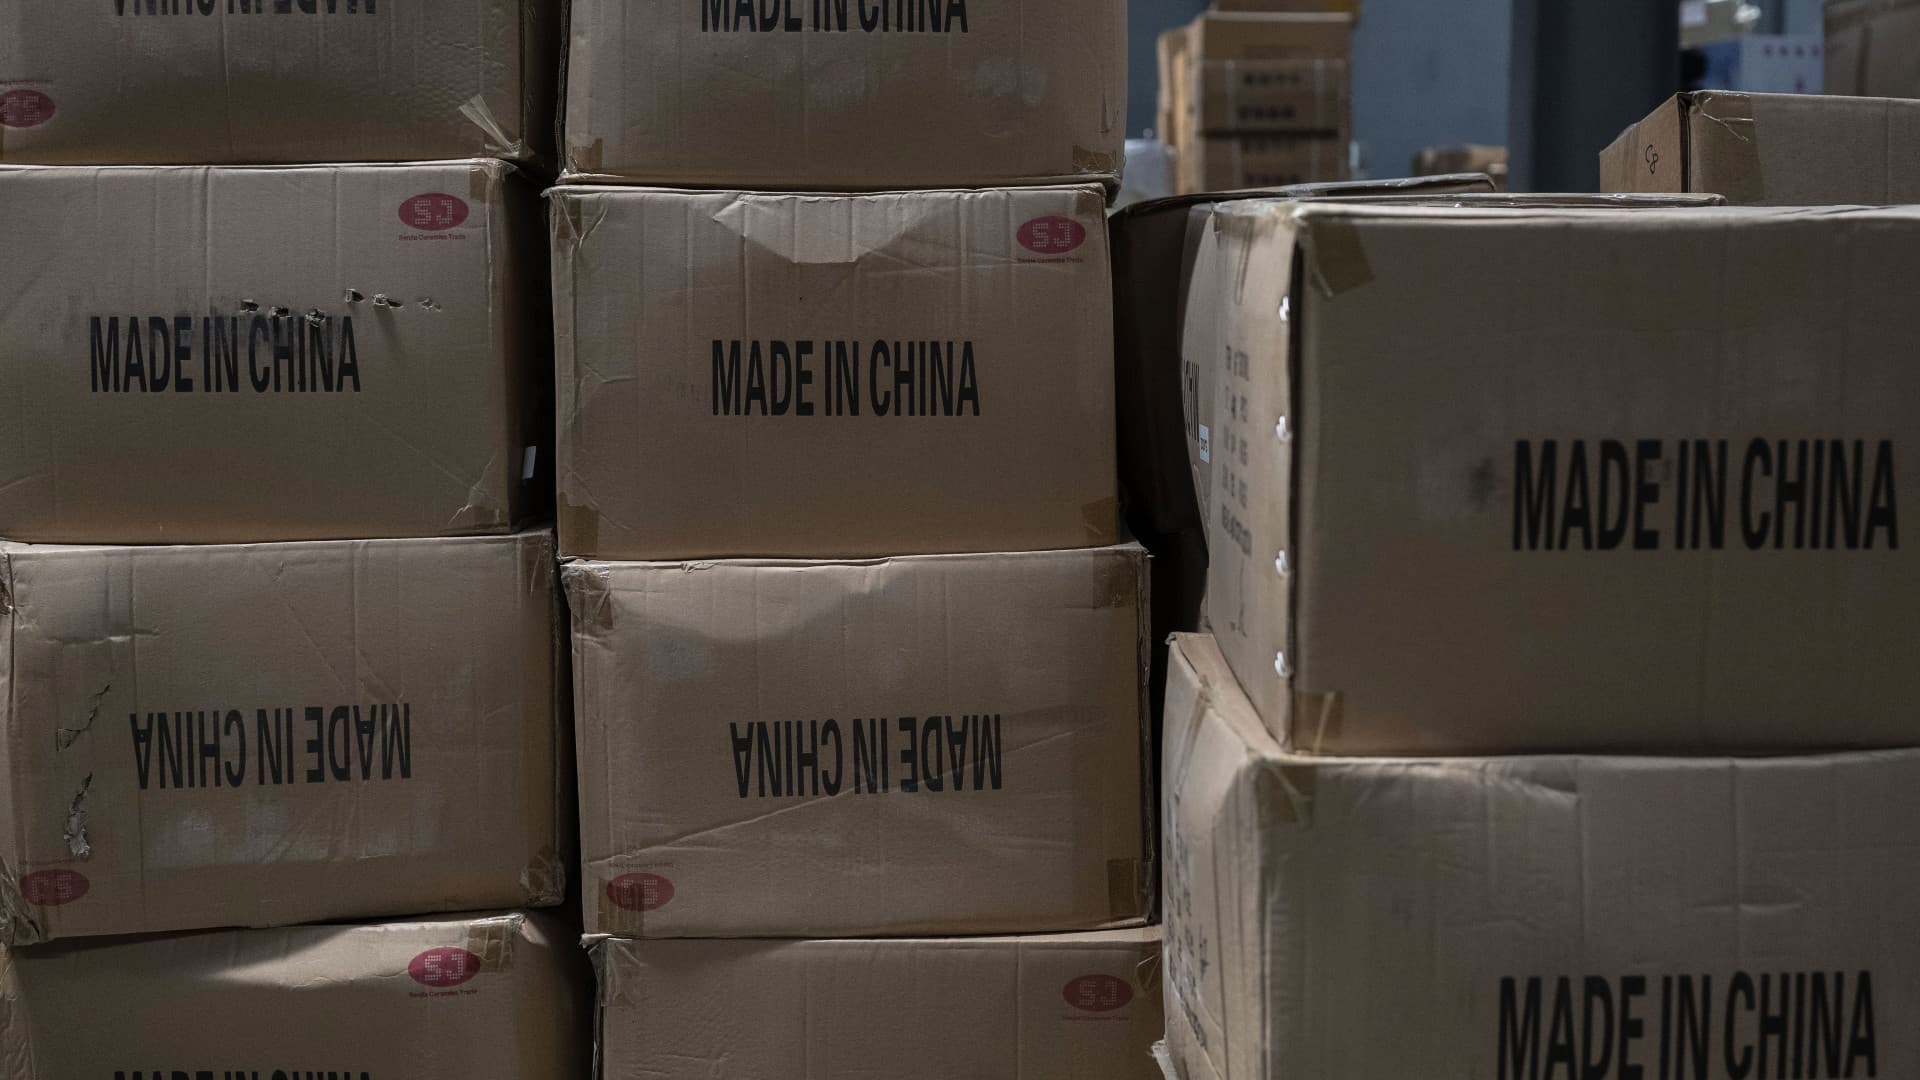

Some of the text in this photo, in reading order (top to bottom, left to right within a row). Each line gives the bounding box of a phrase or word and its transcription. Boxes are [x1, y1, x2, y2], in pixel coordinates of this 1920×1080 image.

[414, 199, 453, 225] SJ
[1032, 222, 1071, 248] SJ
[91, 315, 361, 394] MADE IN CHINA
[711, 339, 980, 417] MADE IN CHINA
[1513, 437, 1898, 550] MADE IN CHINA
[129, 703, 411, 790] MADE IN CHINA
[729, 713, 1003, 799] MADE IN CHINA
[424, 953, 464, 981] SJ
[1079, 981, 1118, 1006] SJ
[1497, 970, 1877, 1080] MADE IN CHINA
